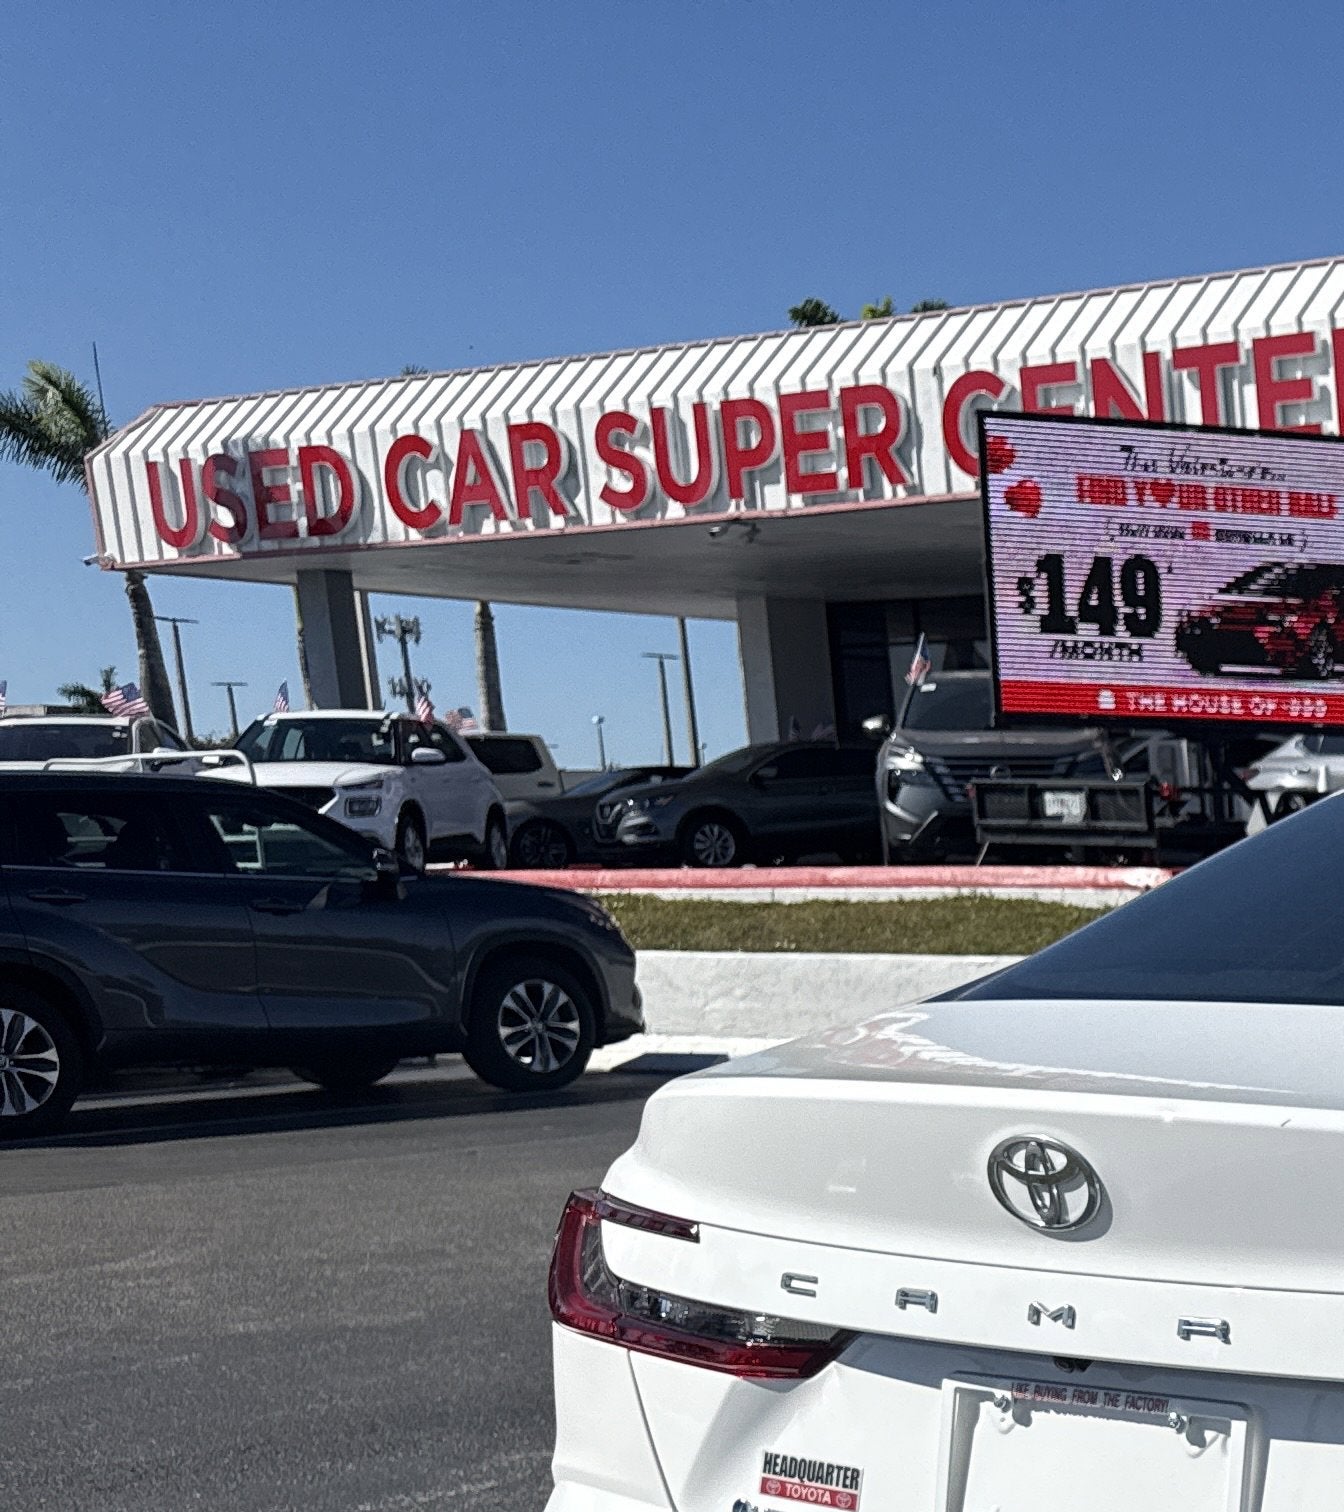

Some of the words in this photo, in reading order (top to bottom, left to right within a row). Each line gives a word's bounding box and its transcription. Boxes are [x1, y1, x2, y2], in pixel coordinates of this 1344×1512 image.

[145, 444, 358, 549] USED
[385, 421, 569, 530] CAR
[595, 384, 909, 512] SUPER
[1126, 691, 1168, 712] THE
[1172, 693, 1244, 715] HOUSE
[1072, 1388, 1099, 1406] FROM
[1103, 1391, 1121, 1409] THE
[762, 1451, 861, 1491] HEADQUARTER
[785, 1483, 832, 1505] TOYOTA
